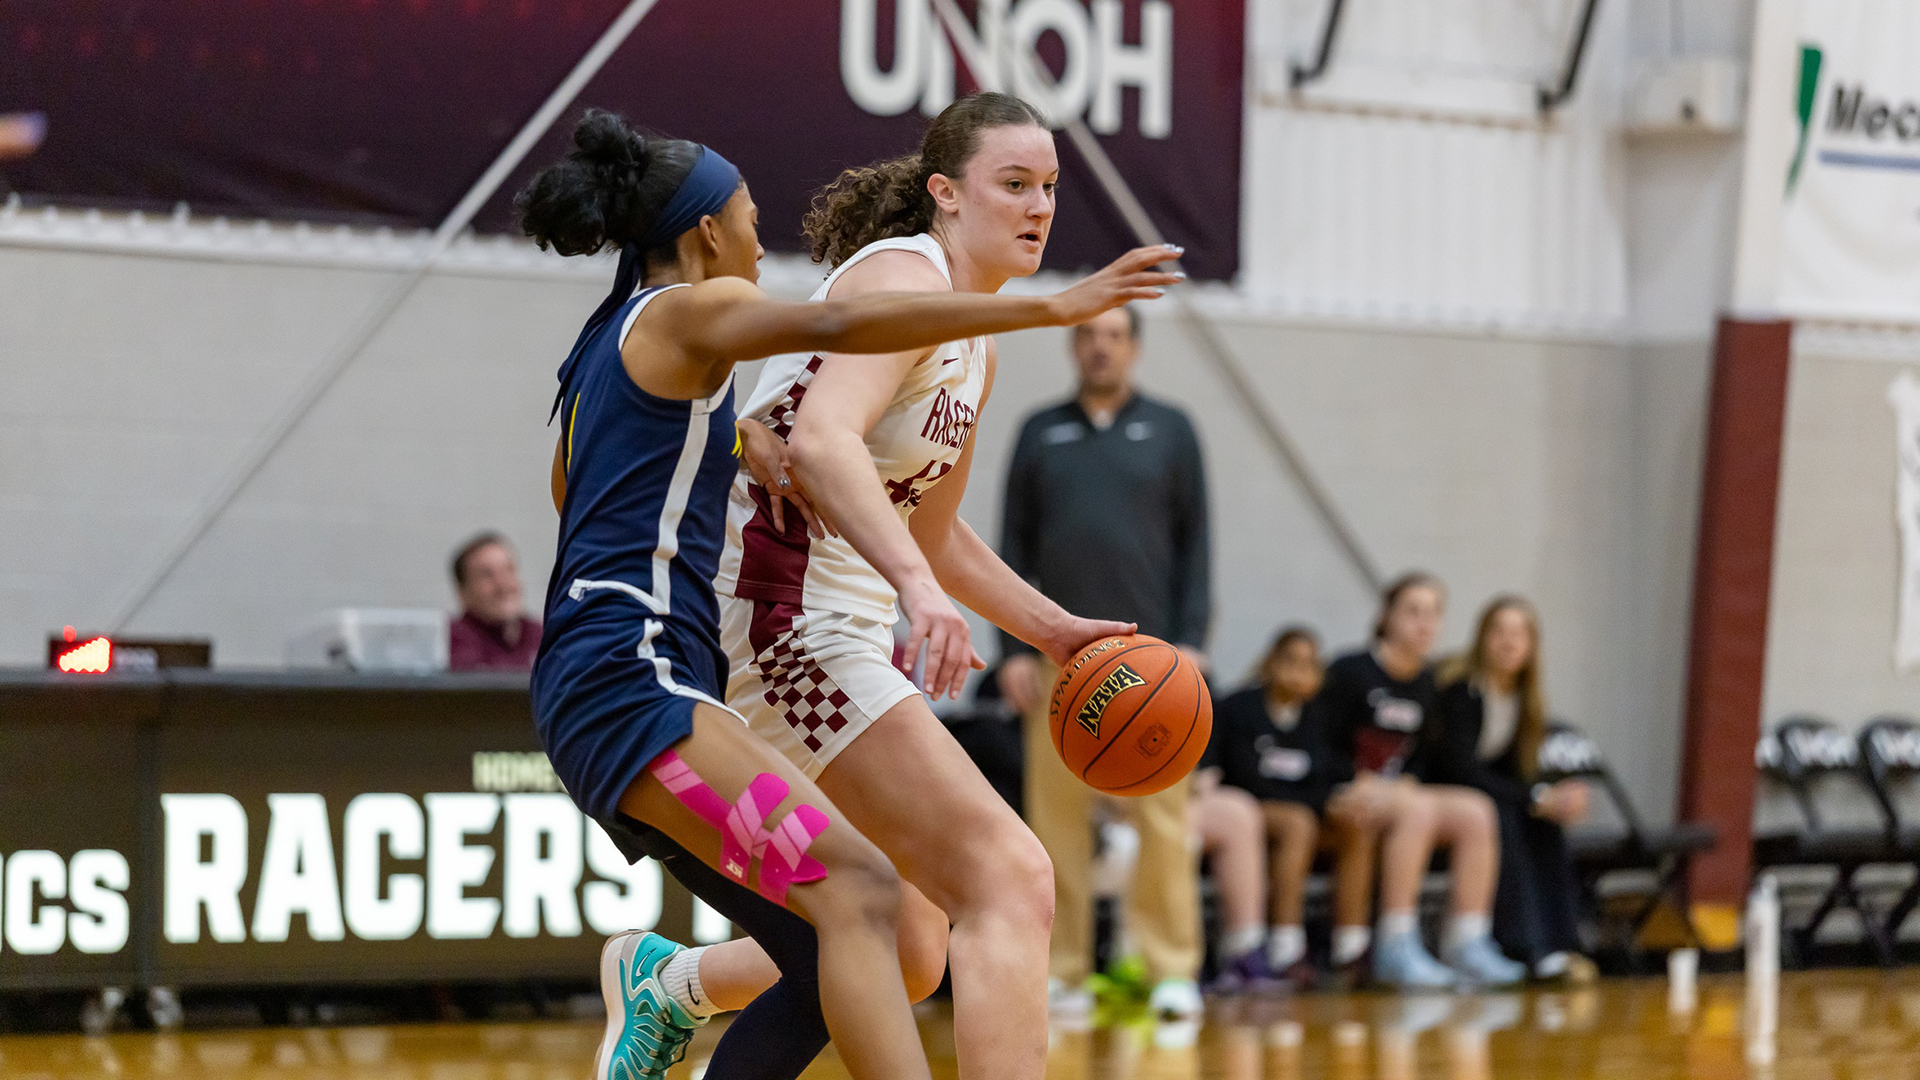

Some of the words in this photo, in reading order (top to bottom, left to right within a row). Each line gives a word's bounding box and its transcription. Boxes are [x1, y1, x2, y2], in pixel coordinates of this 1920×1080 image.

[839, 0, 1173, 139] UNOH
[1050, 638, 1126, 722] SPALDING
[1075, 662, 1149, 740] NAIA
[160, 792, 663, 944] RACERS
